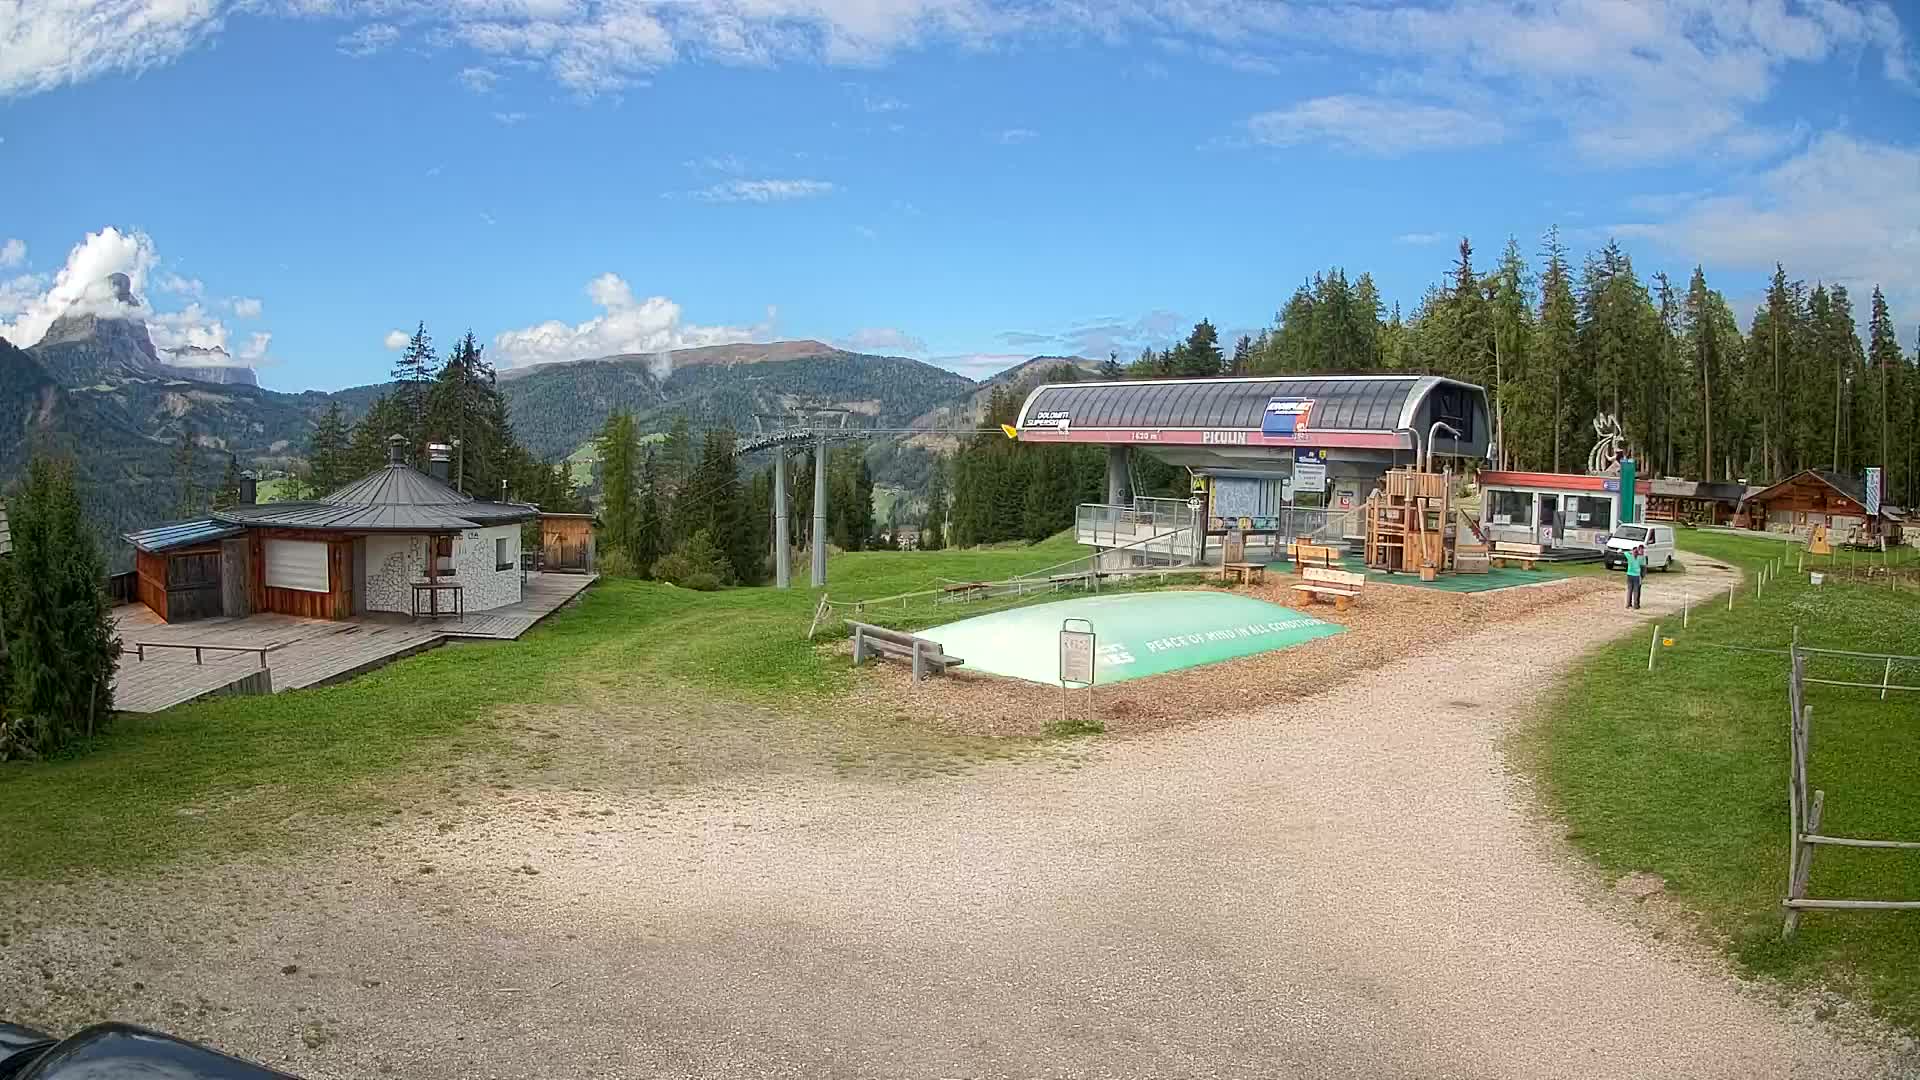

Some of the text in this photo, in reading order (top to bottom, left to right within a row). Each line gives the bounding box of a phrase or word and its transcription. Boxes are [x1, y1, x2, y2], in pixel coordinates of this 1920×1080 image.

[1202, 431, 1246, 445] PICULIN
[1144, 634, 1188, 655] PEACE
[1205, 629, 1235, 641] MIND
[1268, 618, 1326, 632] CONDITIO
